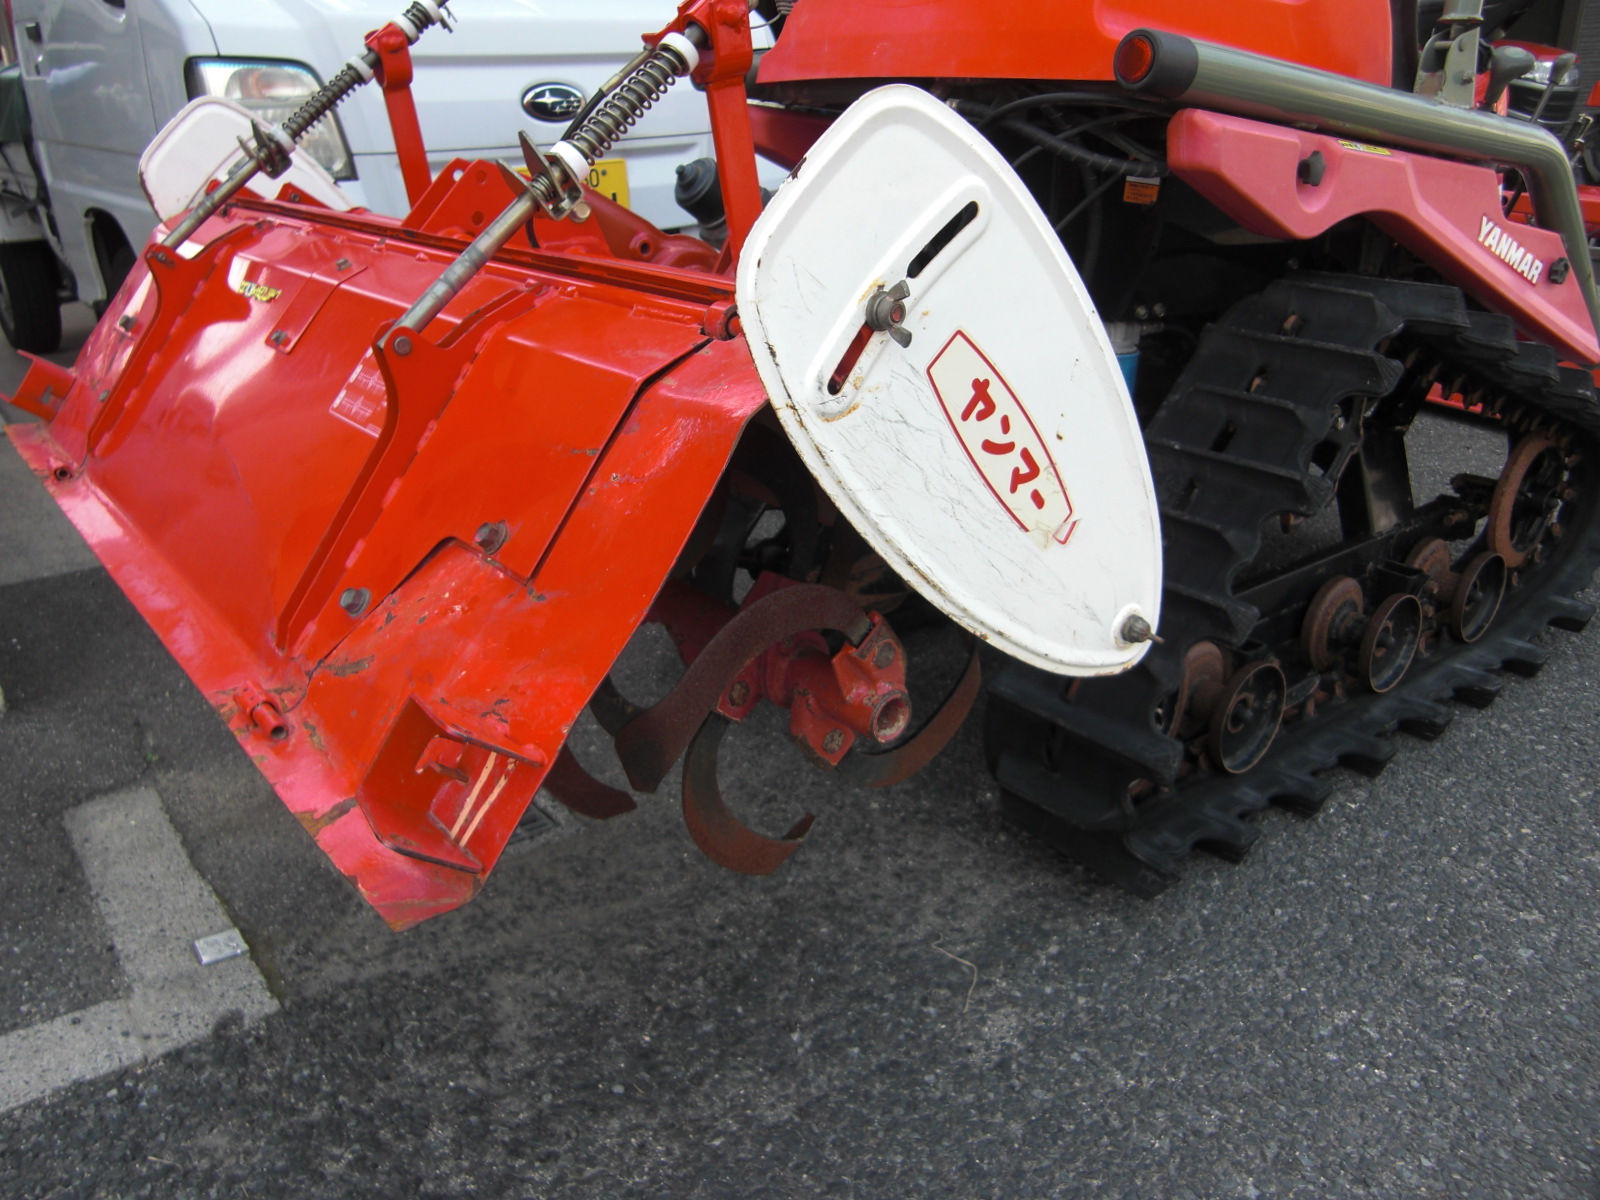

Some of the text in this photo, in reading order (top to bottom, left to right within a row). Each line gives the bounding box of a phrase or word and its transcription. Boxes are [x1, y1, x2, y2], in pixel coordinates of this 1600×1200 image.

[1478, 215, 1543, 284] YANMAR
[961, 378, 1045, 509] ヤンマー
